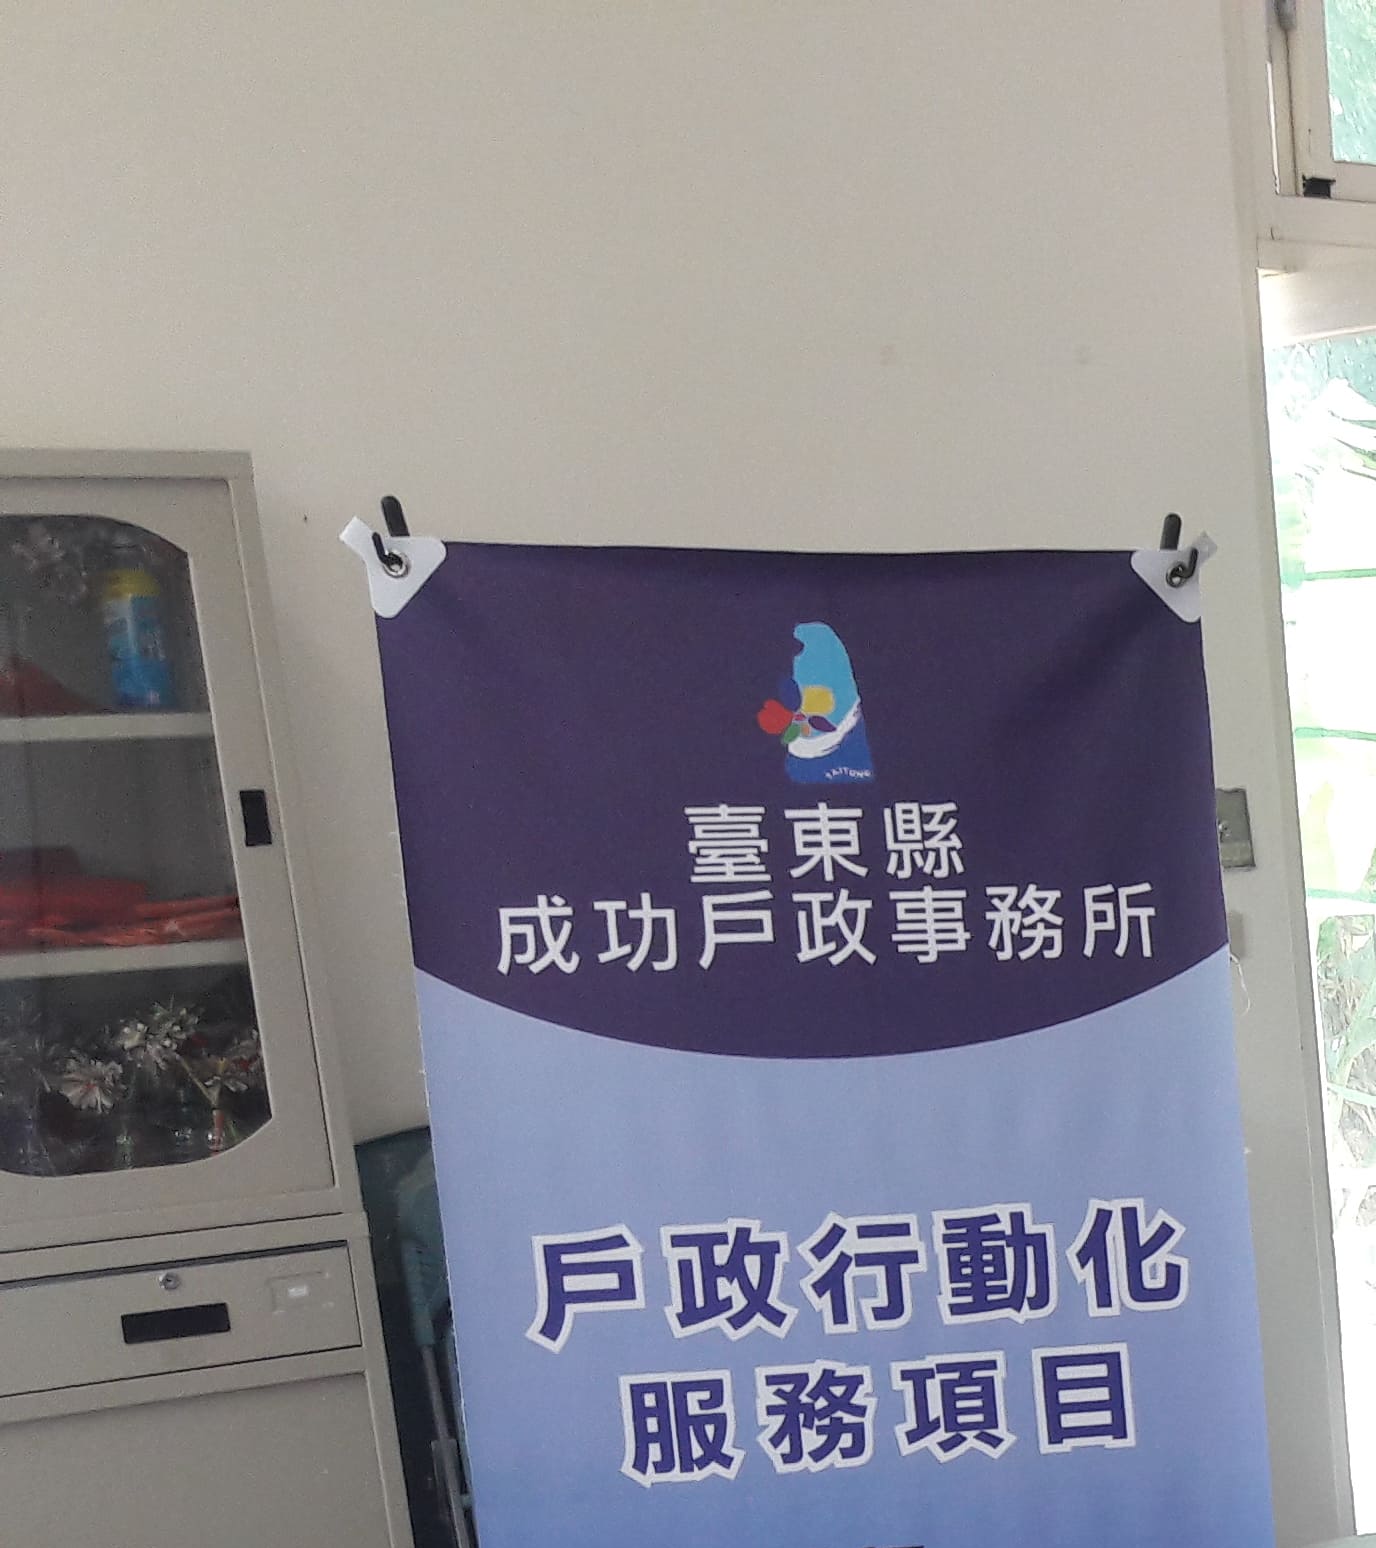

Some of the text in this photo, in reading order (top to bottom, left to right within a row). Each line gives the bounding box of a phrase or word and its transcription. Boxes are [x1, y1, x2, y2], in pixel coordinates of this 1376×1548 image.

[684, 802, 965, 883] 臺東縣
[497, 881, 1156, 975] 成功戶政事務所
[528, 1198, 1187, 1351] 戶政行動化
[619, 1343, 1137, 1486] 服務項目
